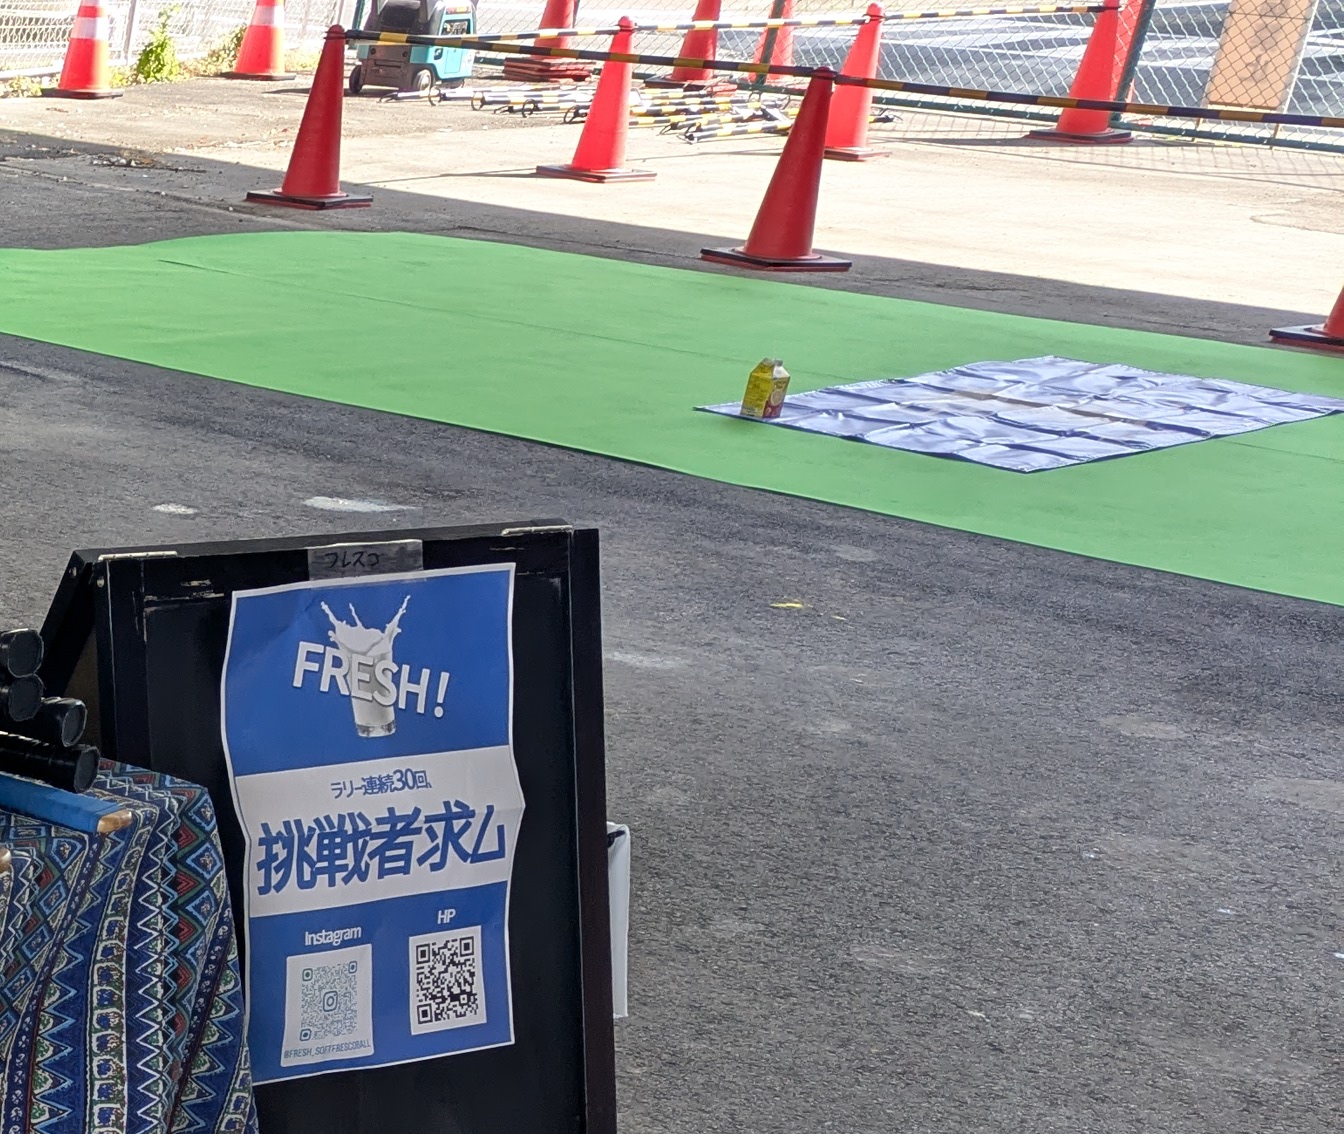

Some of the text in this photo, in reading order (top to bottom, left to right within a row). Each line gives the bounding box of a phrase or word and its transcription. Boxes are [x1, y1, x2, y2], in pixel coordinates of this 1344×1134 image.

[292, 641, 450, 718] FRESH!
[256, 799, 506, 896] 挑戦者求ム
[304, 926, 362, 947] Instagram
[437, 908, 457, 925] HP
